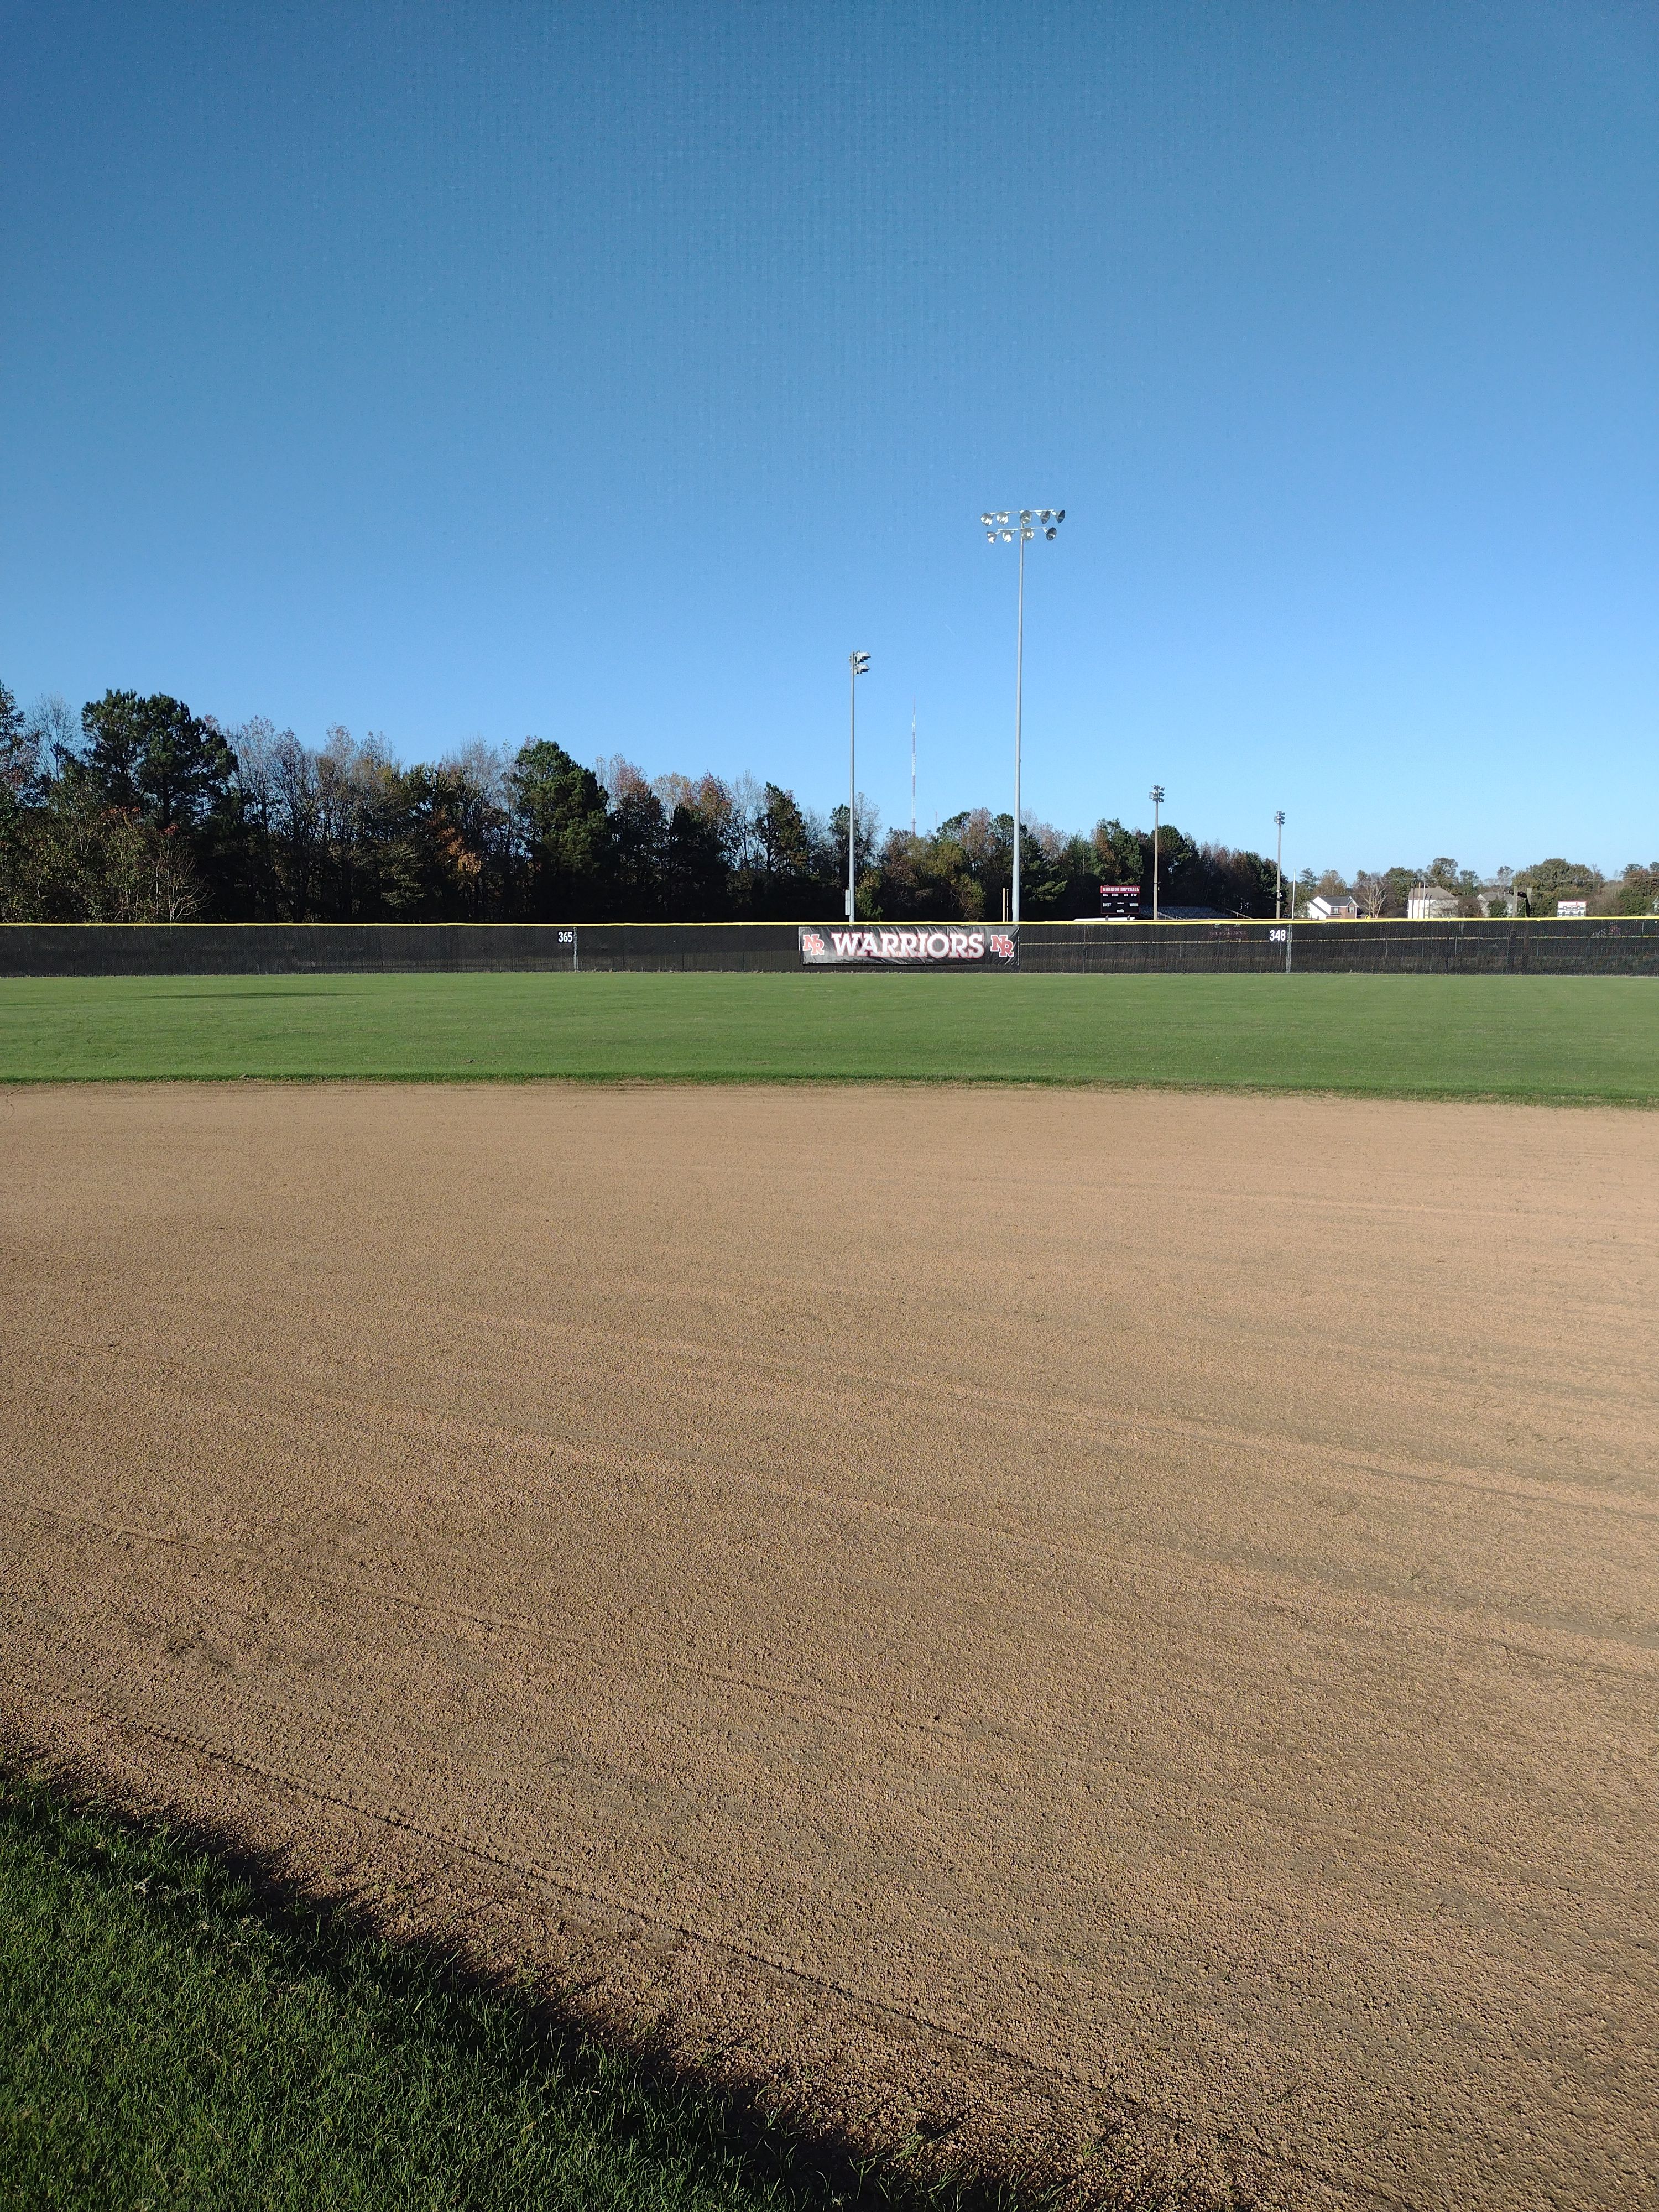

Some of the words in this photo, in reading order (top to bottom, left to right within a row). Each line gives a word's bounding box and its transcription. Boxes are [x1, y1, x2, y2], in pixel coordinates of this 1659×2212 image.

[558, 932, 573, 942] 365
[1269, 930, 1286, 941] 348
[831, 932, 984, 958] WARRIORS
